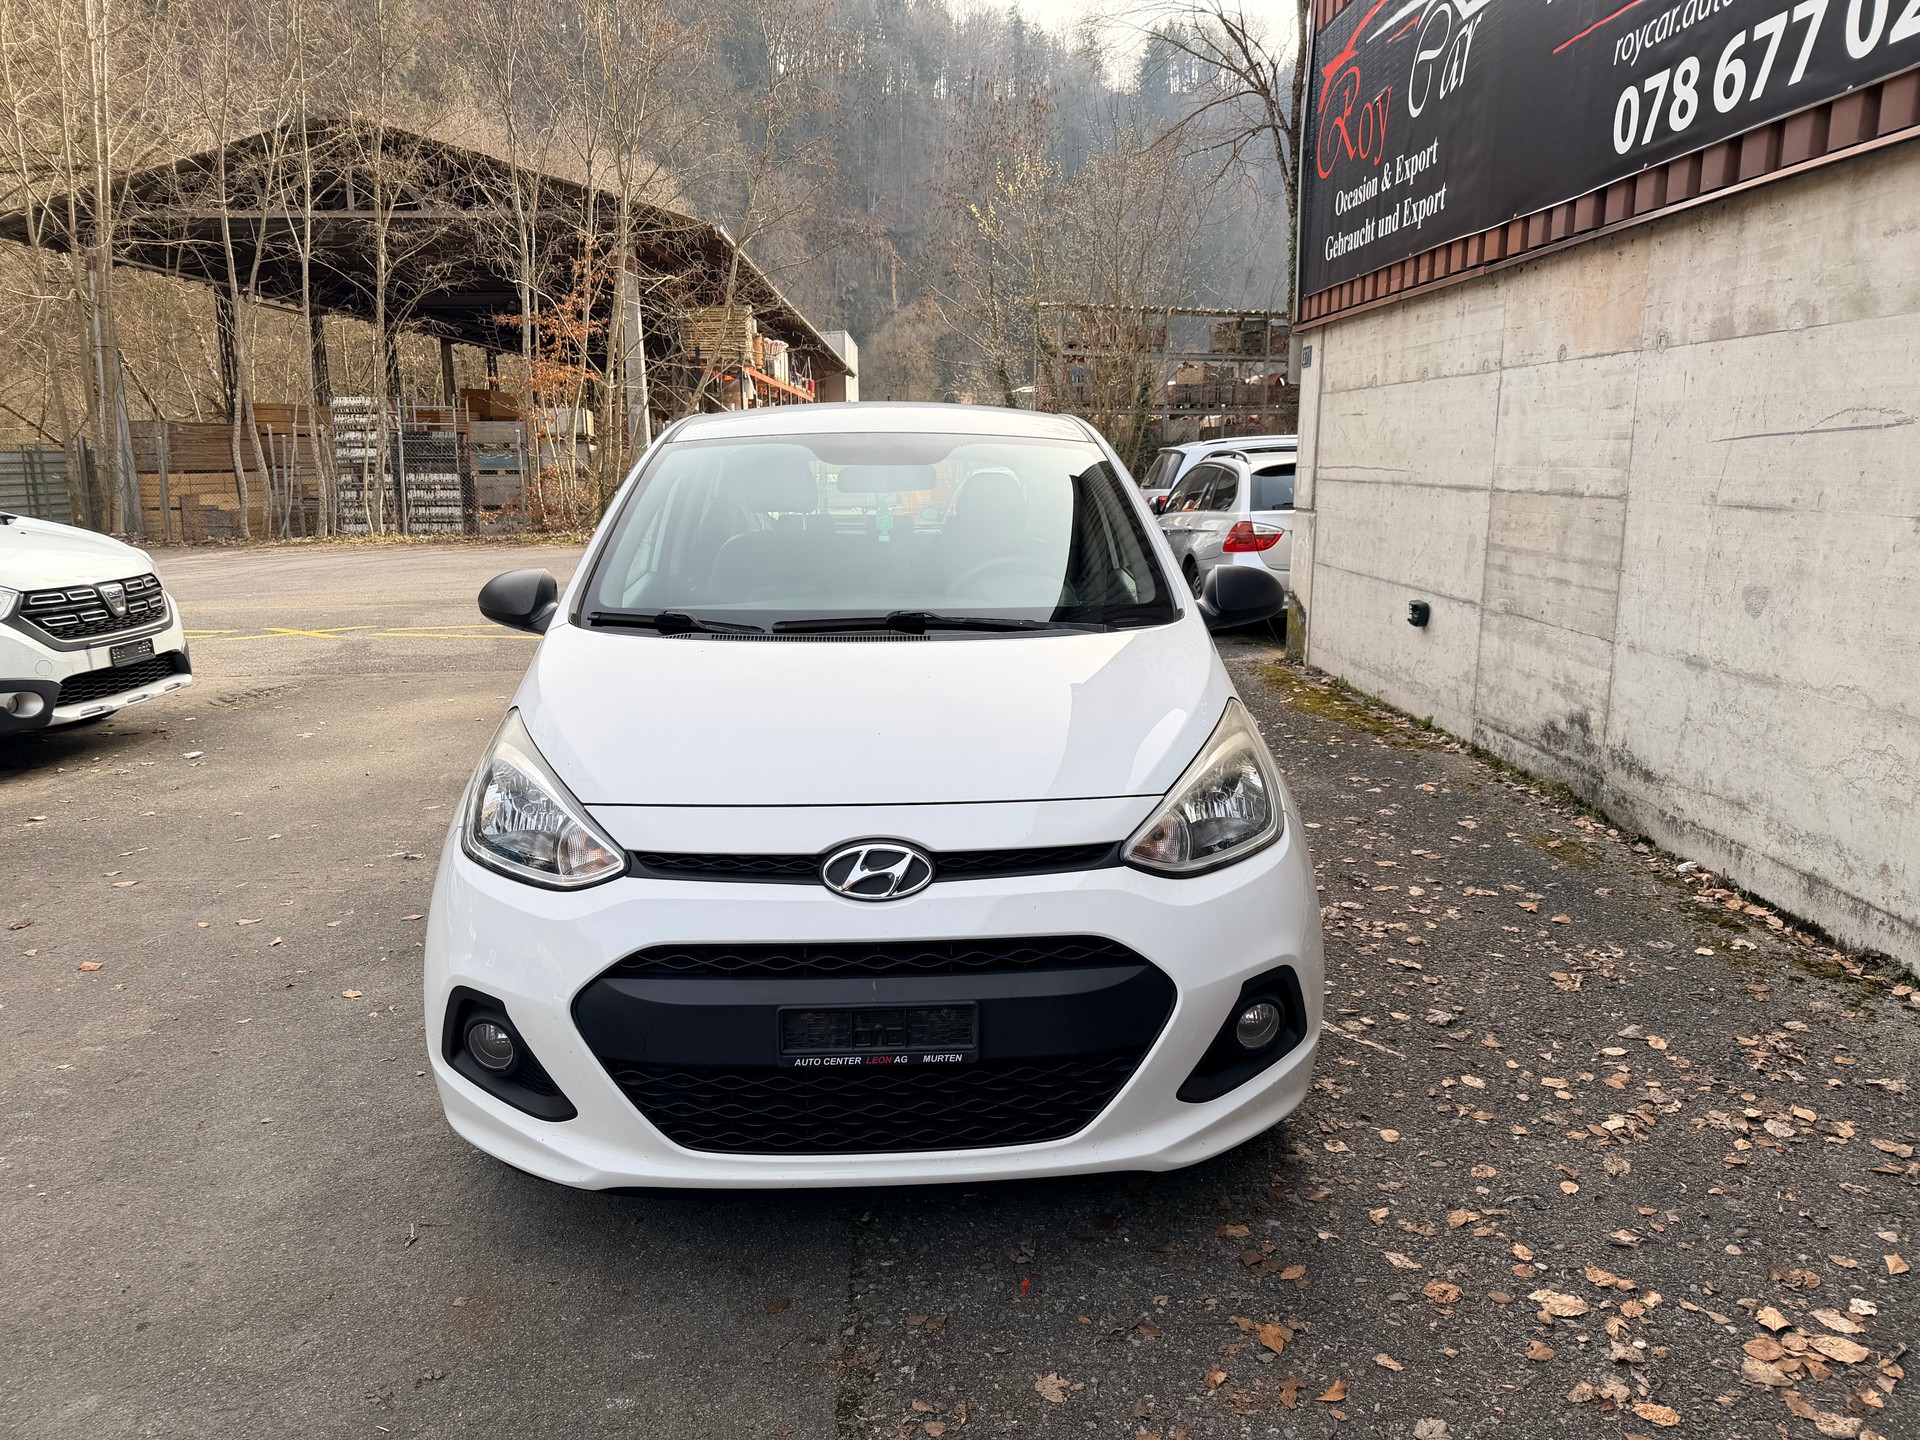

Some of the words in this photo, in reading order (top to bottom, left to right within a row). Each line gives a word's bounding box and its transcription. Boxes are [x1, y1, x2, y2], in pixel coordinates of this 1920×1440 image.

[1613, 0, 1733, 67] roycar.au
[1316, 65, 1393, 180] Roy
[1408, 2, 1483, 118] Car
[1613, 56, 1700, 155] 078
[1713, 0, 1829, 114] 677
[1335, 175, 1379, 216] Occasion
[1381, 162, 1393, 192] &
[1394, 136, 1439, 186] Export
[1324, 217, 1376, 261] Gebraucht
[1377, 203, 1401, 239] und
[1401, 182, 1447, 230] Export
[793, 1057, 822, 1067] AUTO
[823, 1056, 862, 1066] CENTER
[865, 1055, 893, 1065] LEON
[893, 1055, 909, 1064] AG
[922, 1053, 963, 1063] MURTEN
